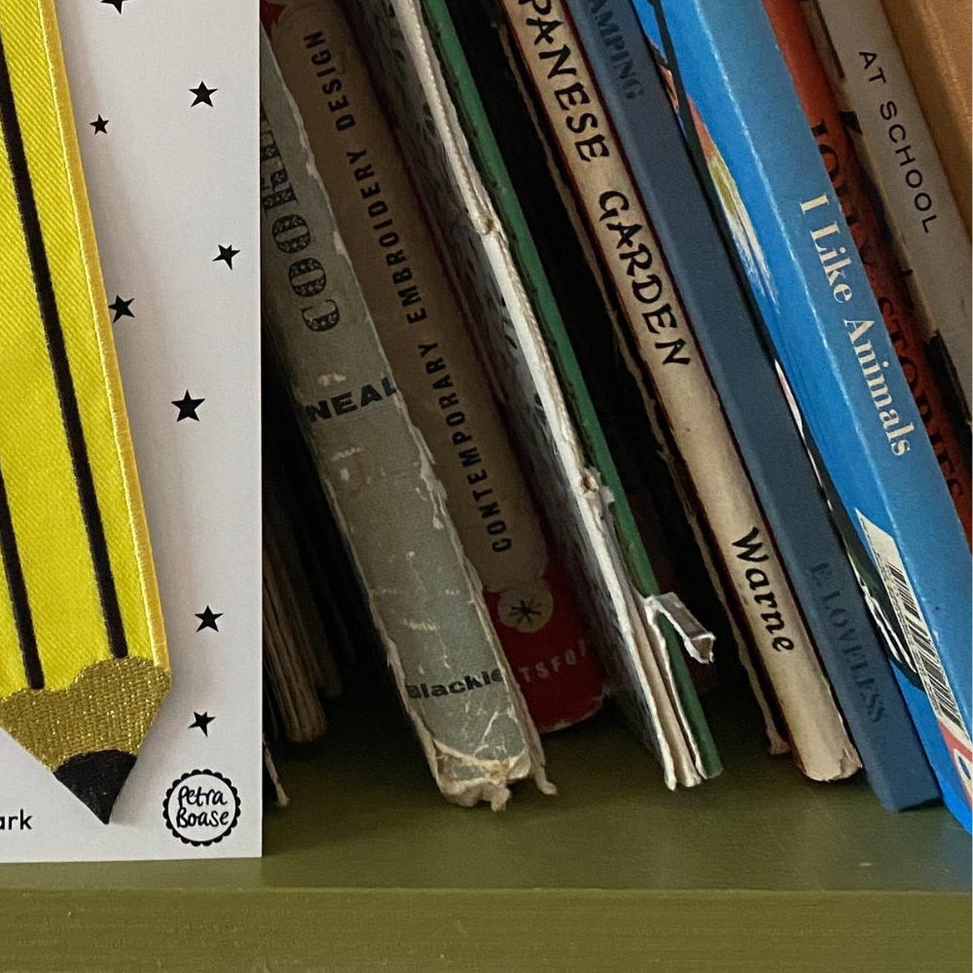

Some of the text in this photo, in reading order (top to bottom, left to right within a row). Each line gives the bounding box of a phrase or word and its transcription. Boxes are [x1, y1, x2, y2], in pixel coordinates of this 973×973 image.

[799, 194, 830, 214] I
[858, 51, 938, 233] AT SCHOOL
[303, 30, 513, 554] CONTEMPORARY EMBROIDERY DESIGN
[598, 190, 691, 365] GARDEN
[810, 221, 852, 303] Like
[844, 318, 915, 457] Animals
[732, 527, 794, 652] Warne
[823, 590, 885, 723] LOVELESS
[176, 807, 229, 828] Boase
[178, 785, 228, 807] Petra
